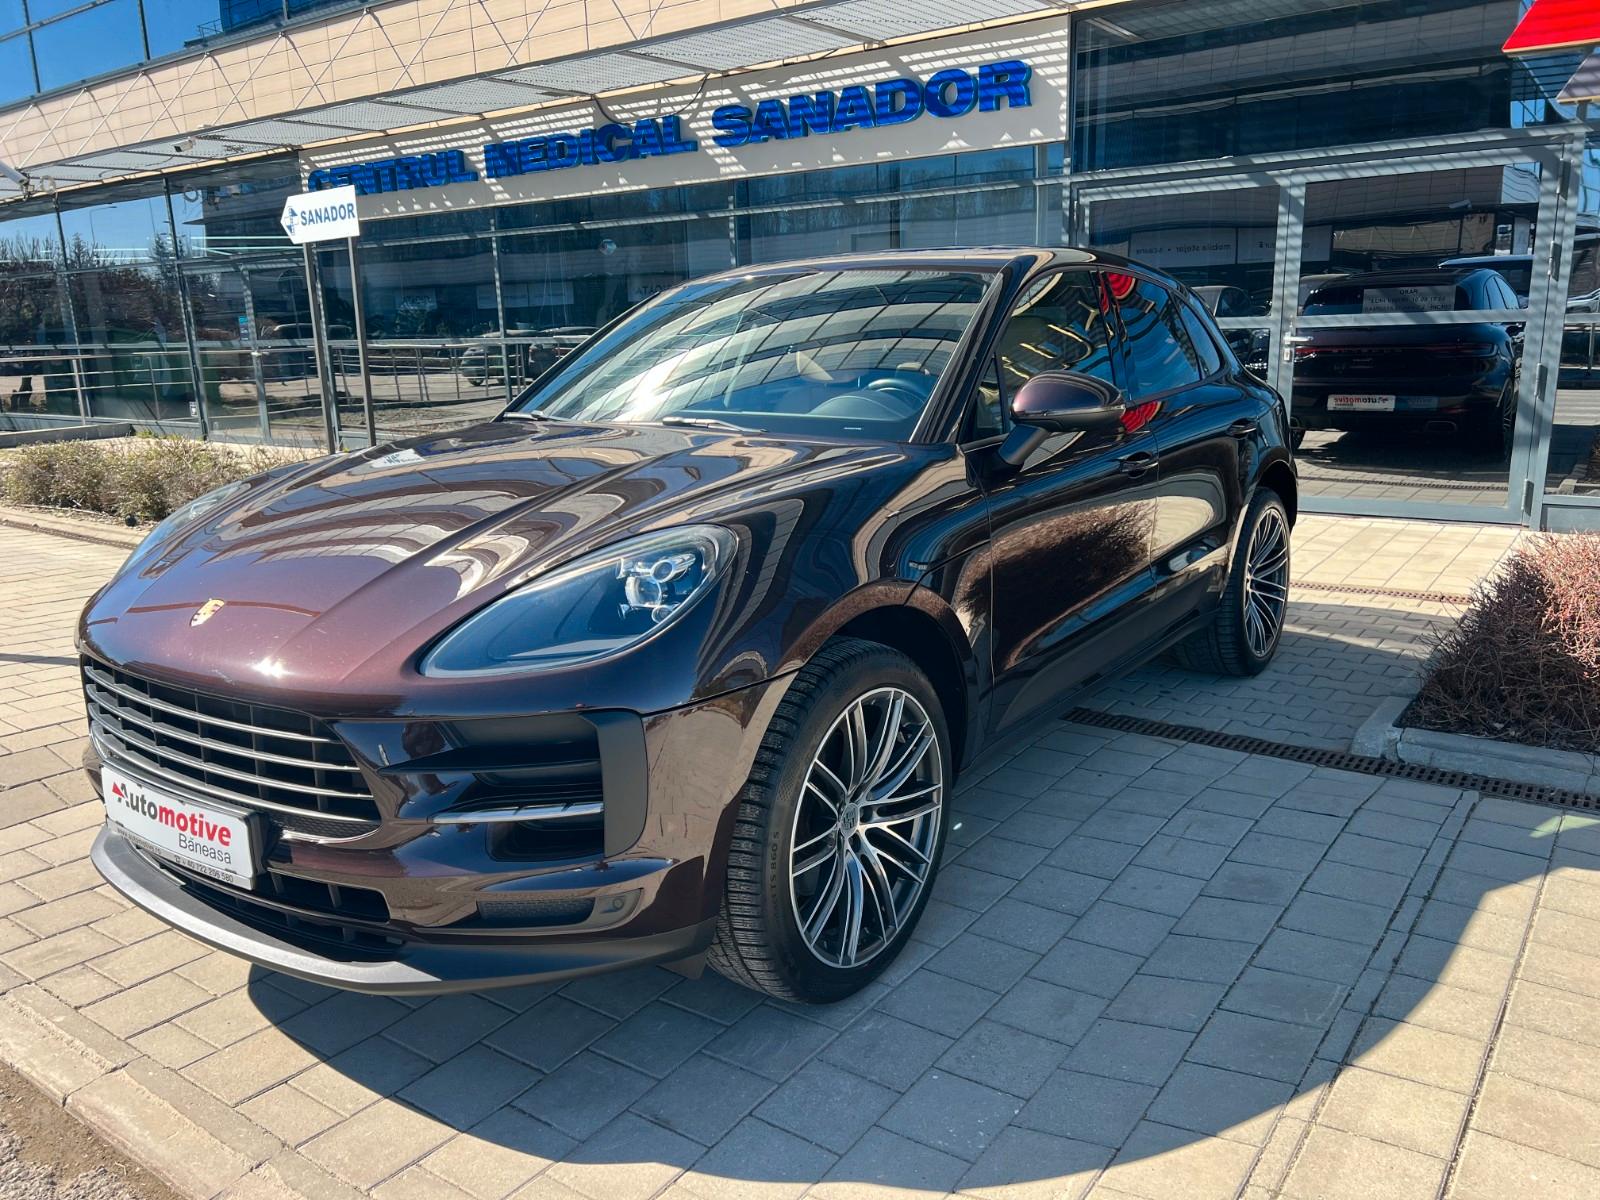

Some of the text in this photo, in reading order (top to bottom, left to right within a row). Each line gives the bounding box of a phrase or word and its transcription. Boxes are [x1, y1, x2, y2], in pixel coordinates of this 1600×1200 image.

[307, 60, 1033, 195] CENTRUL MEDICAL SANADOR
[300, 202, 356, 227] SANADOR
[112, 782, 232, 846] Automotive
